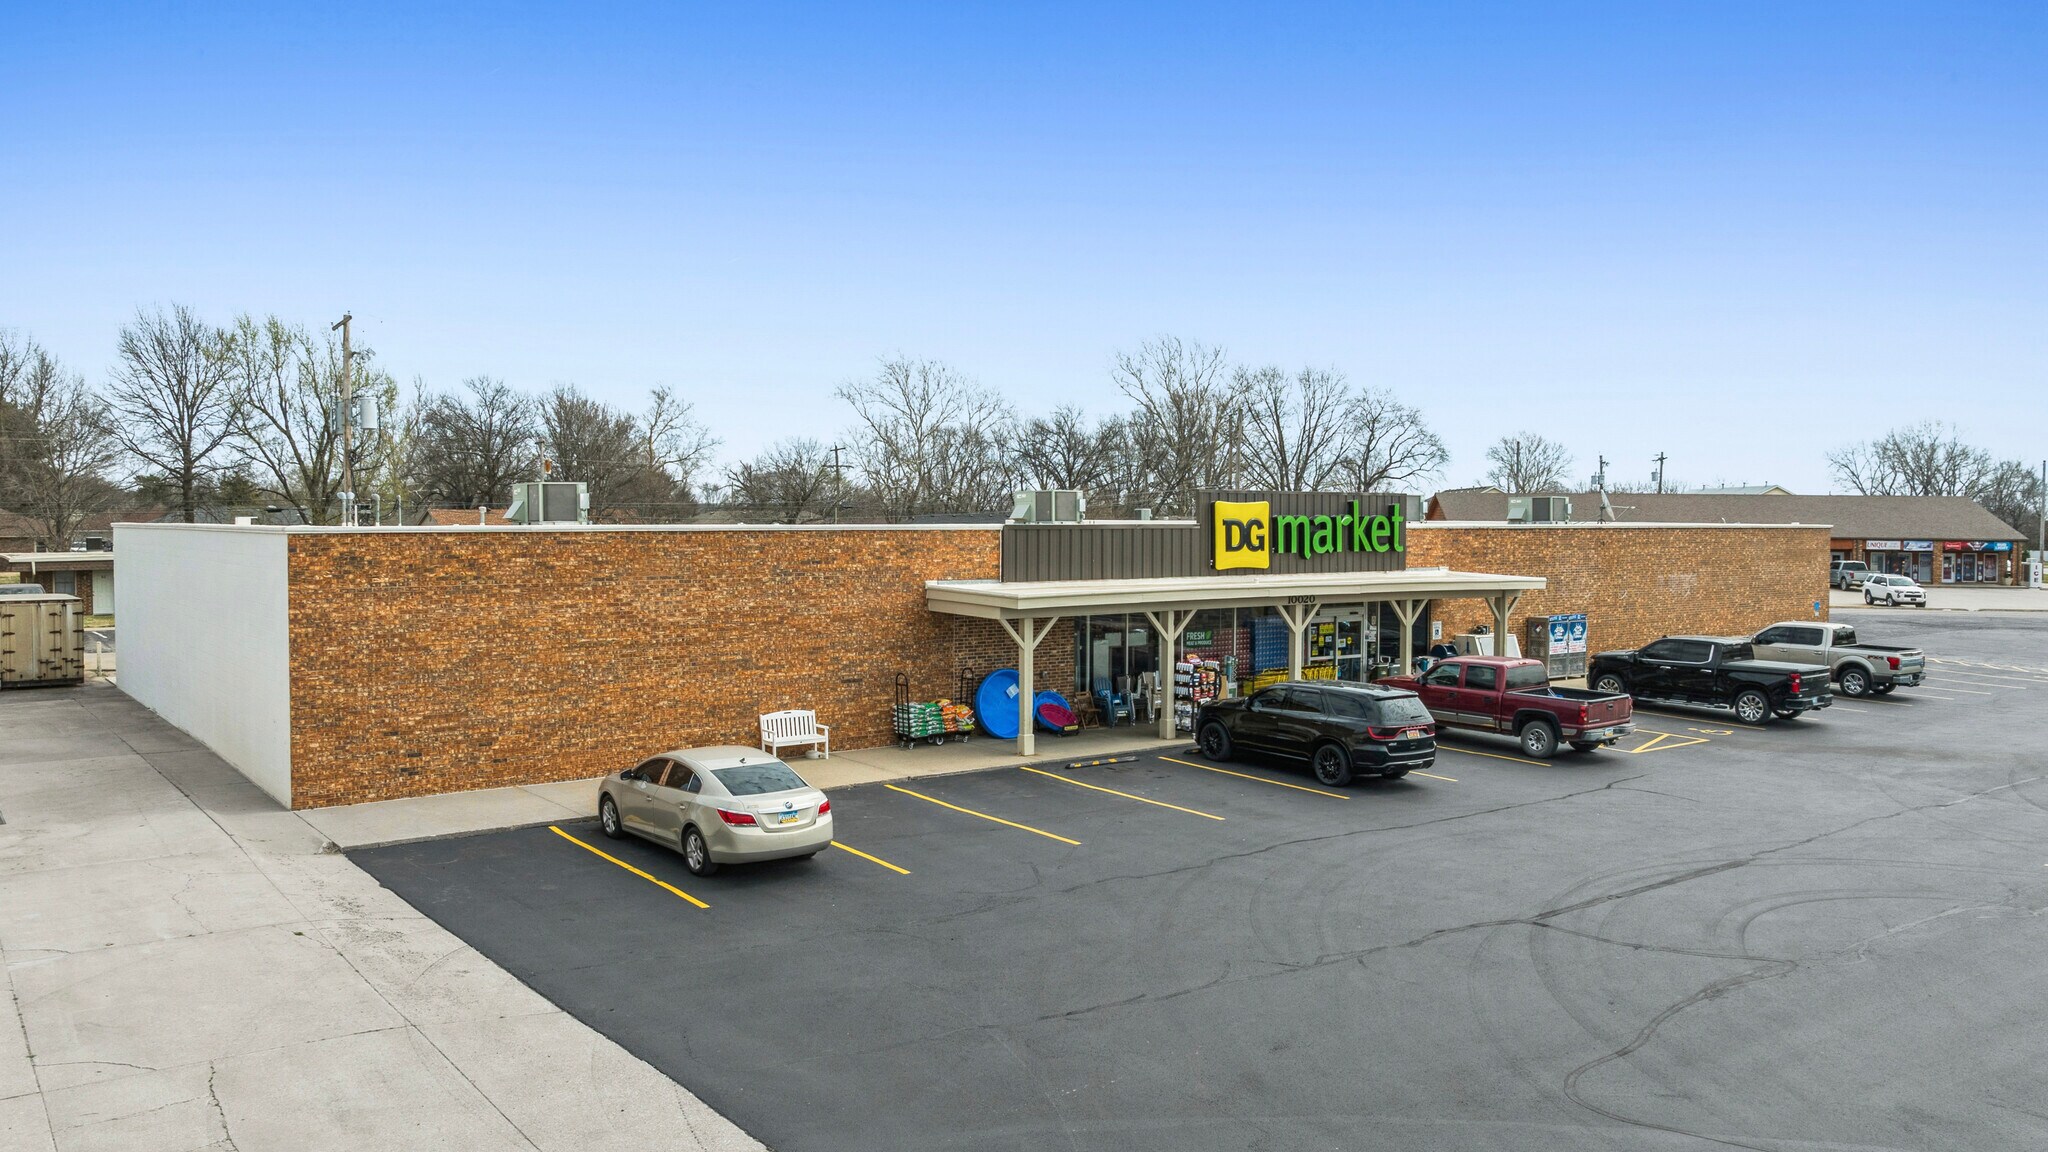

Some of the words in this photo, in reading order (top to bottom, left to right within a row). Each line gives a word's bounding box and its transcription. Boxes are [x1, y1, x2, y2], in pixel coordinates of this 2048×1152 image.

[1222, 518, 1265, 552] DG
[1277, 499, 1404, 560] market
[1288, 595, 1315, 604] 10020
[1186, 632, 1205, 640] FRESH
